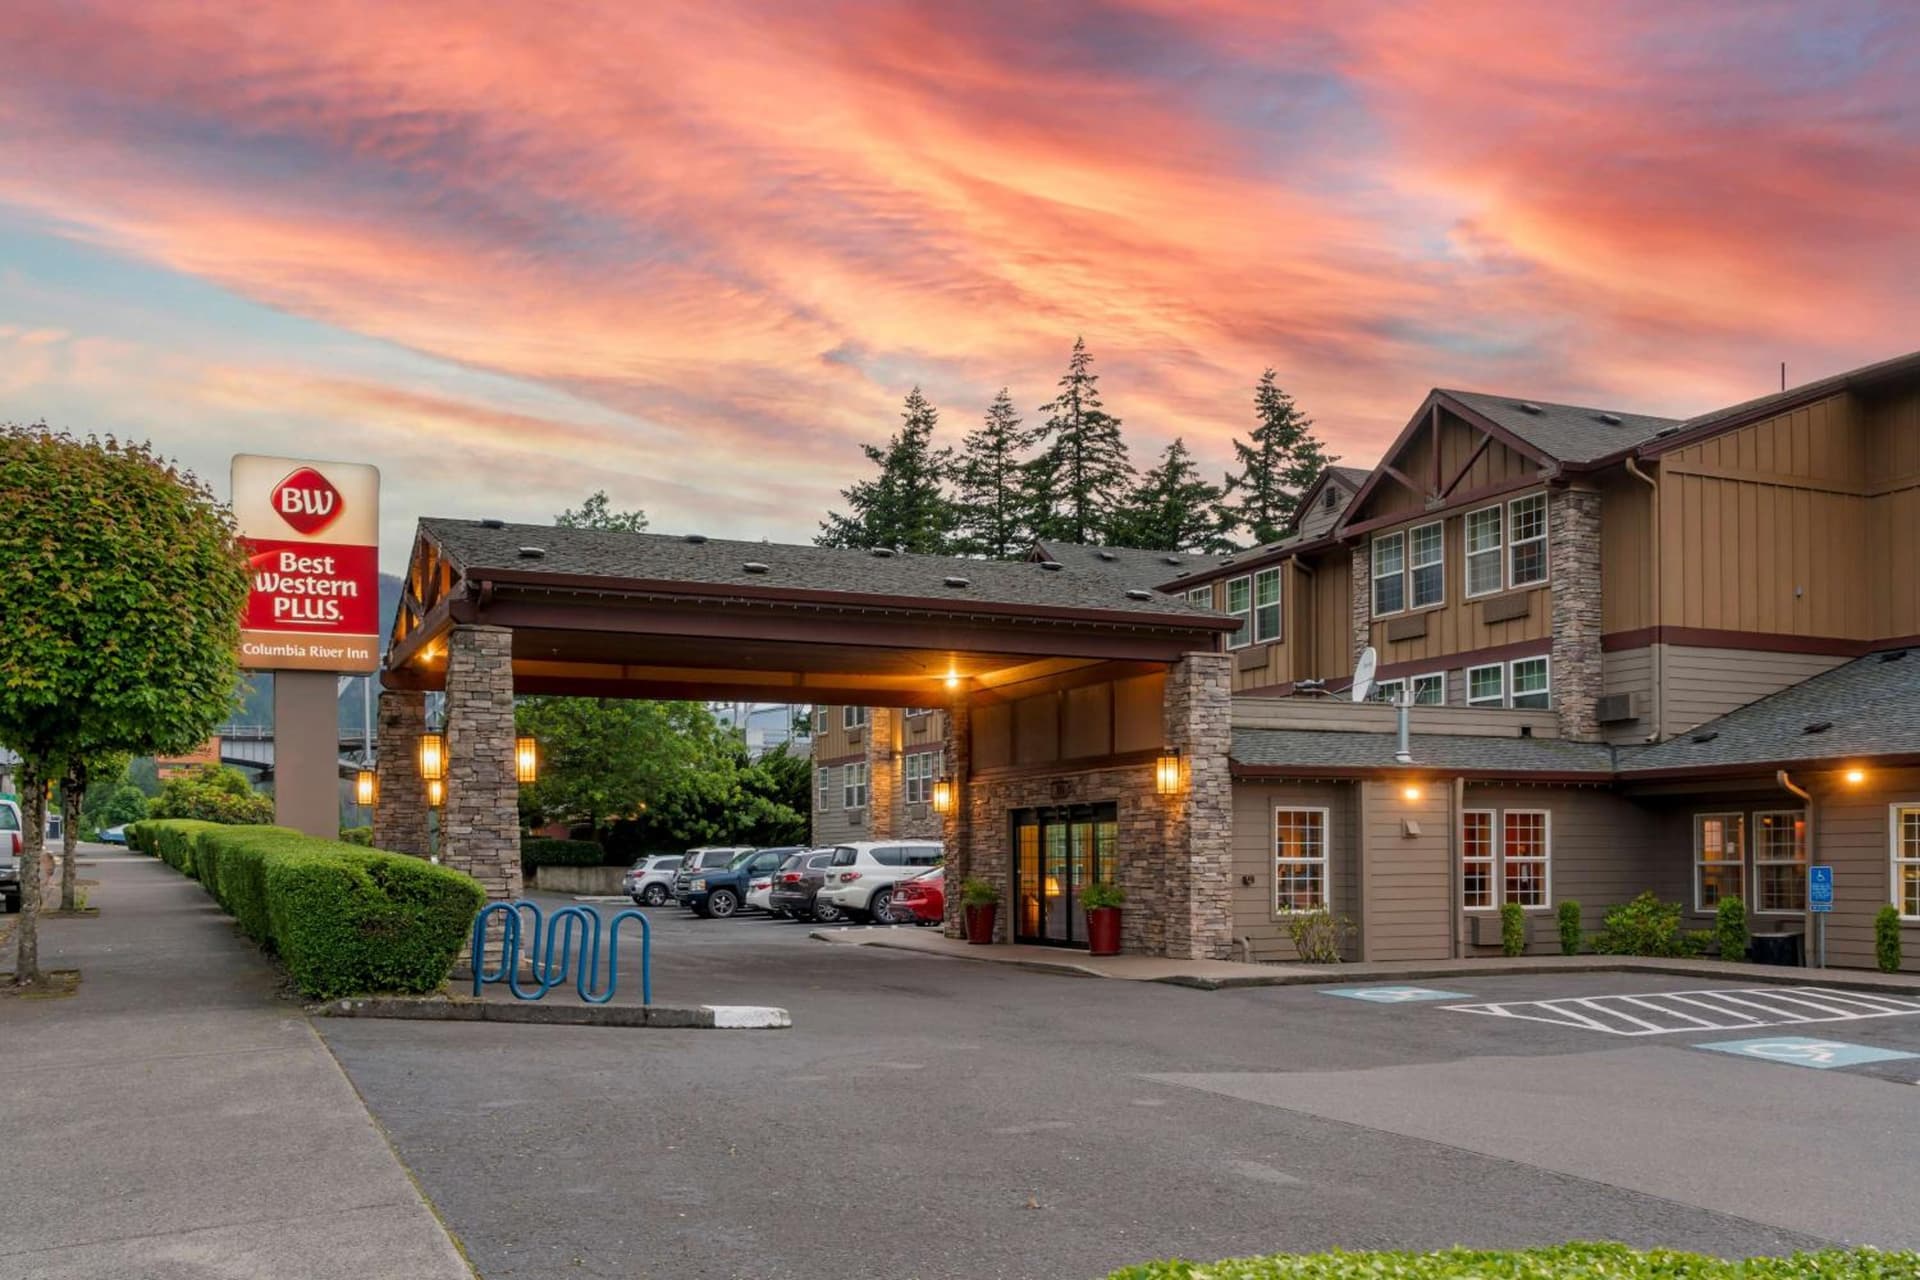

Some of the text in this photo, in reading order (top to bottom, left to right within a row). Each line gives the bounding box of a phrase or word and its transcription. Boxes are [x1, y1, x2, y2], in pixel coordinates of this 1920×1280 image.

[281, 487, 333, 515] BW
[279, 552, 335, 575] Best
[255, 572, 357, 596] Western
[242, 642, 369, 659] Columbia River Inn
